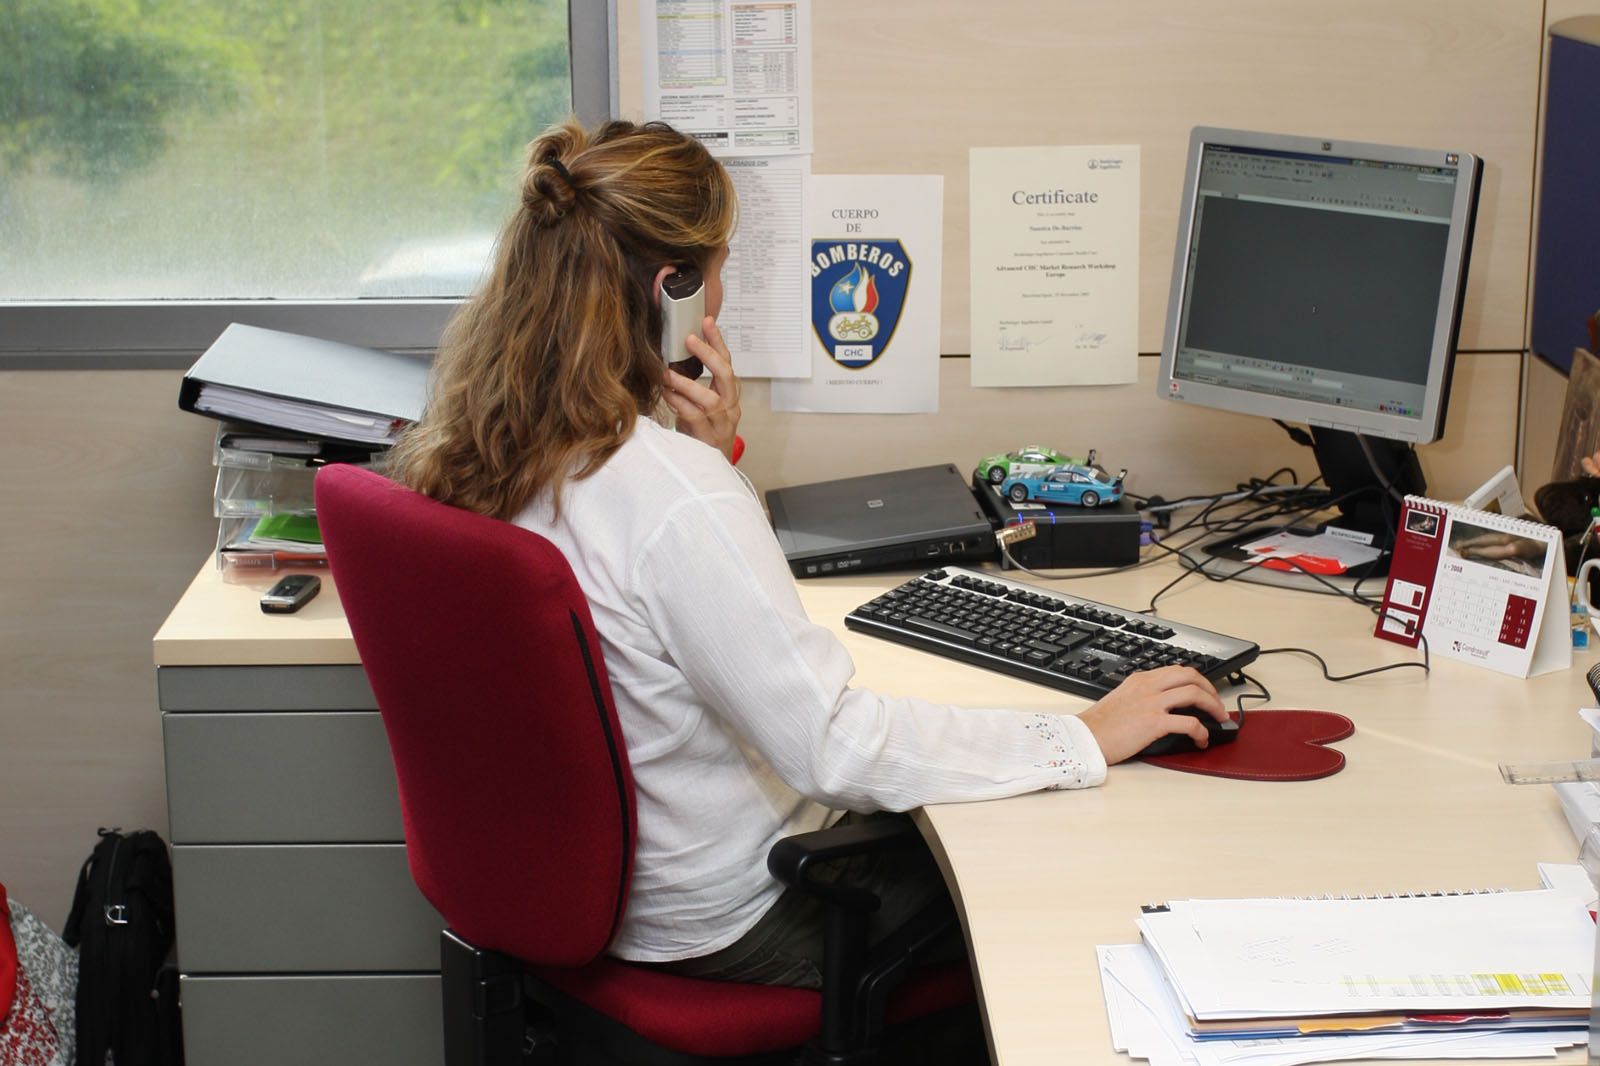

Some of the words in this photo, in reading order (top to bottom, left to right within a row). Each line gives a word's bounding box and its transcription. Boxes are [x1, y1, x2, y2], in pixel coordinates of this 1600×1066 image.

[1012, 189, 1099, 206] Certificate
[831, 208, 879, 219] CUERPO
[846, 223, 862, 233] DE
[811, 243, 904, 278] BOMBEROS
[843, 348, 864, 357] CHC
